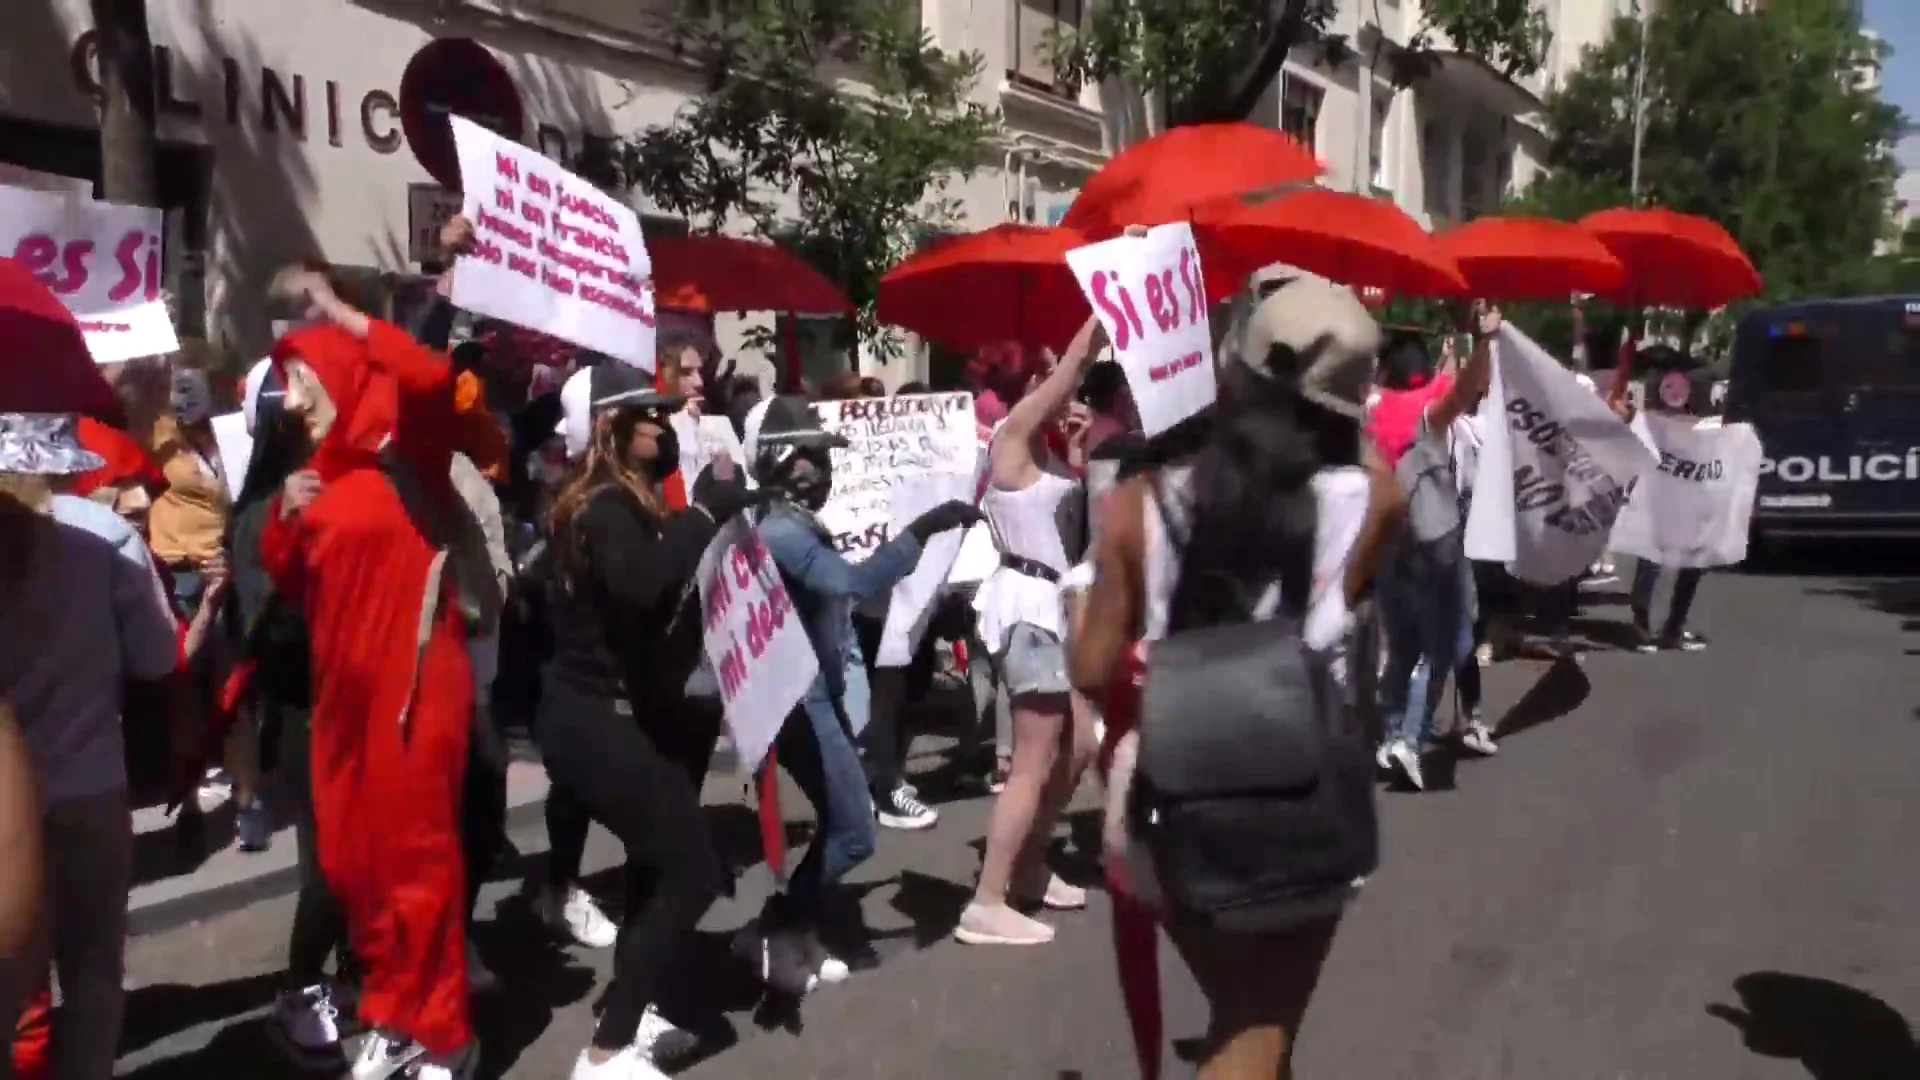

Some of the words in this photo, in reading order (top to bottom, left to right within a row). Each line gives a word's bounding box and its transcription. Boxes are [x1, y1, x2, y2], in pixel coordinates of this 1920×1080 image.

[13, 232, 96, 293] es
[108, 231, 160, 303] Si
[1090, 269, 1145, 351] Si
[1144, 268, 1180, 334] es
[1179, 246, 1206, 326] Si
